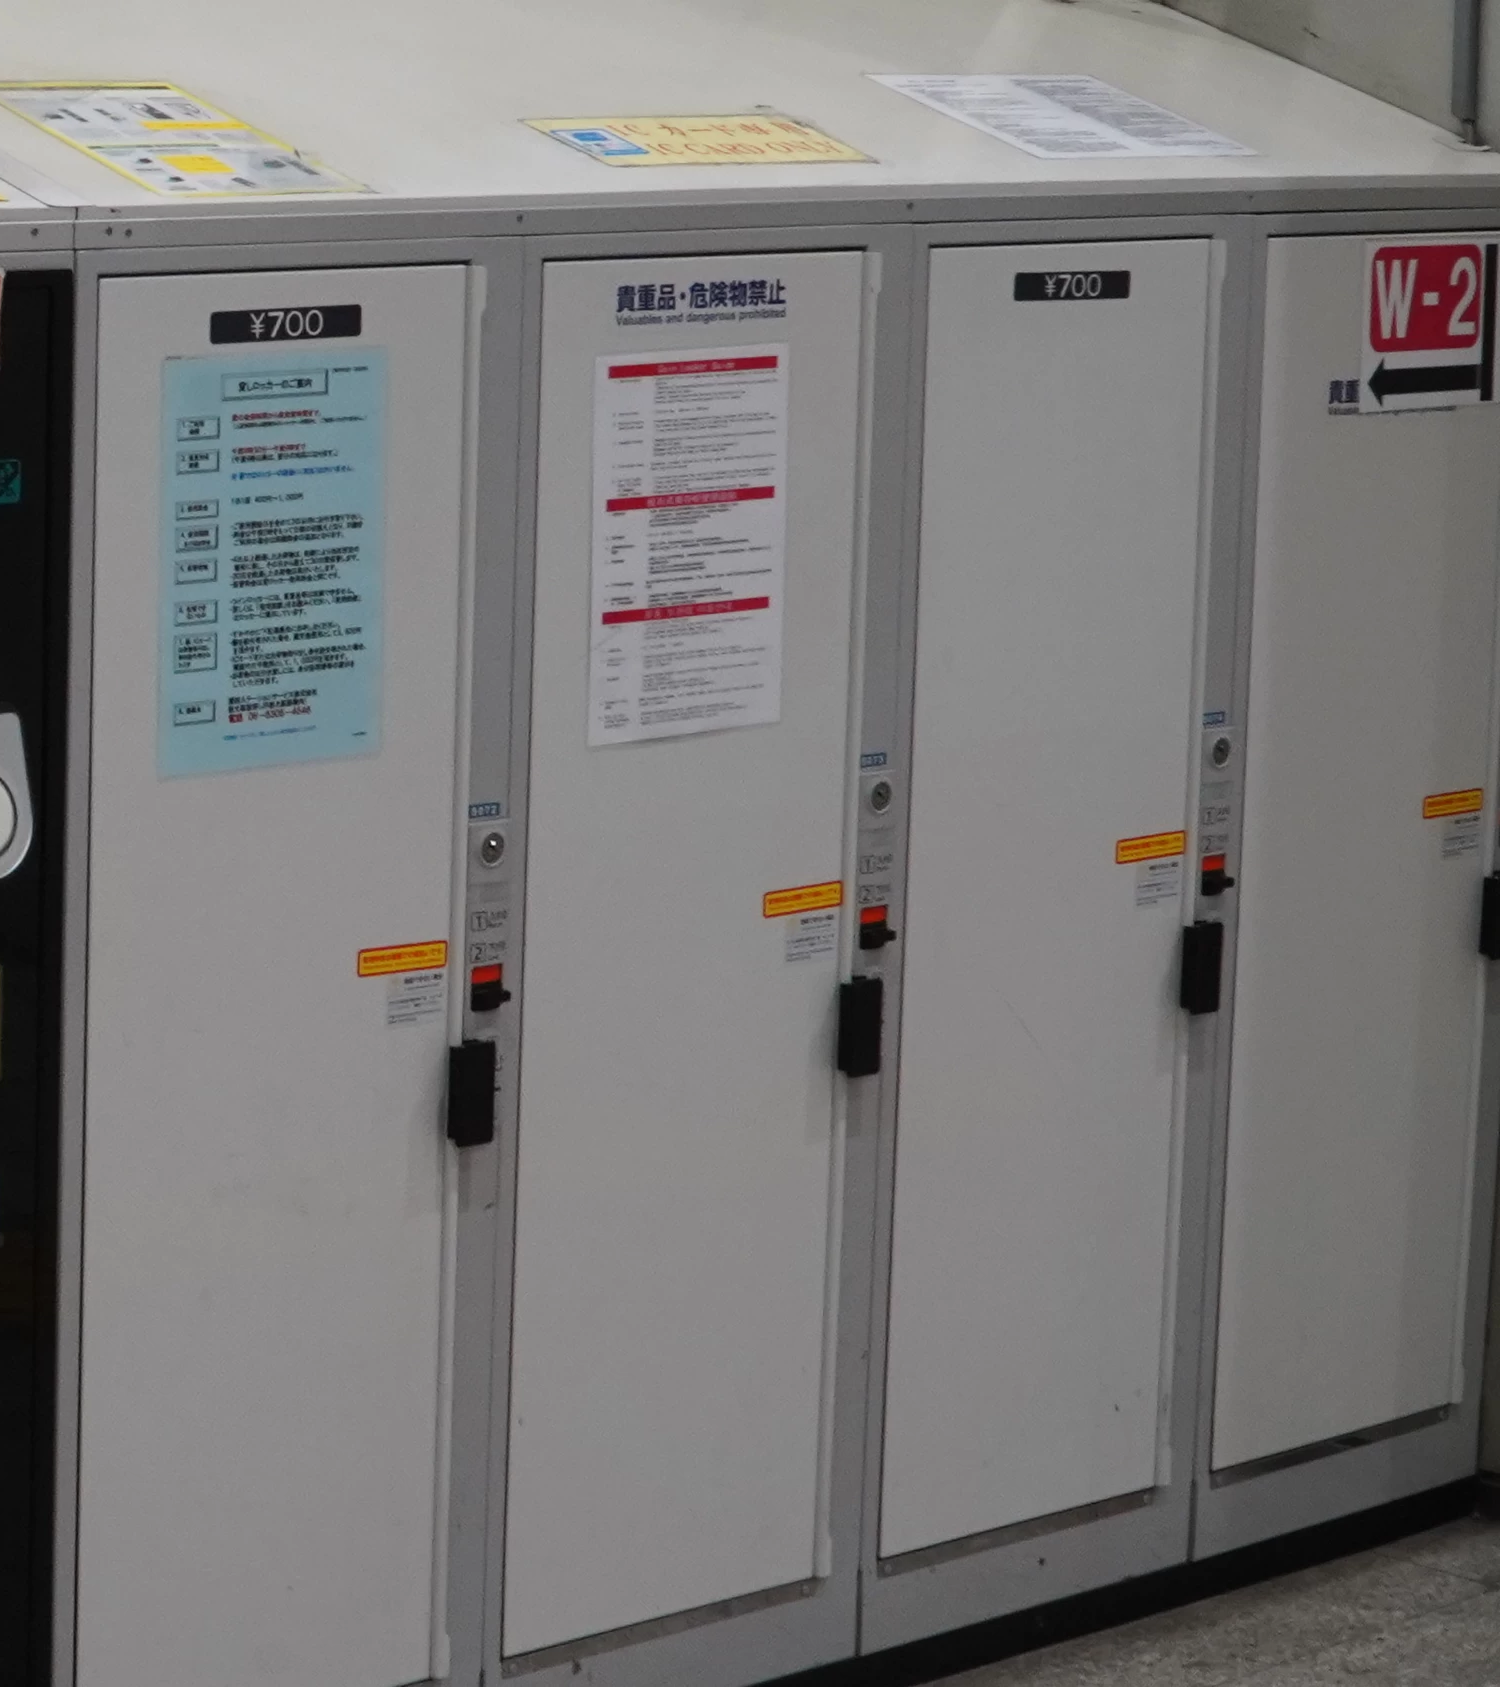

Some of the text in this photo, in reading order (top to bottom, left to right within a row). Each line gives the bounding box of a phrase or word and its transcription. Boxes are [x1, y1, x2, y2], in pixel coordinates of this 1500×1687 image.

[616, 278, 787, 313] 貴重品・危険物禁止
[1044, 273, 1103, 299] ¥700
[1373, 256, 1479, 340] W-2
[249, 308, 325, 340] ¥700
[616, 307, 787, 327] Valuables and dangerous prohibited
